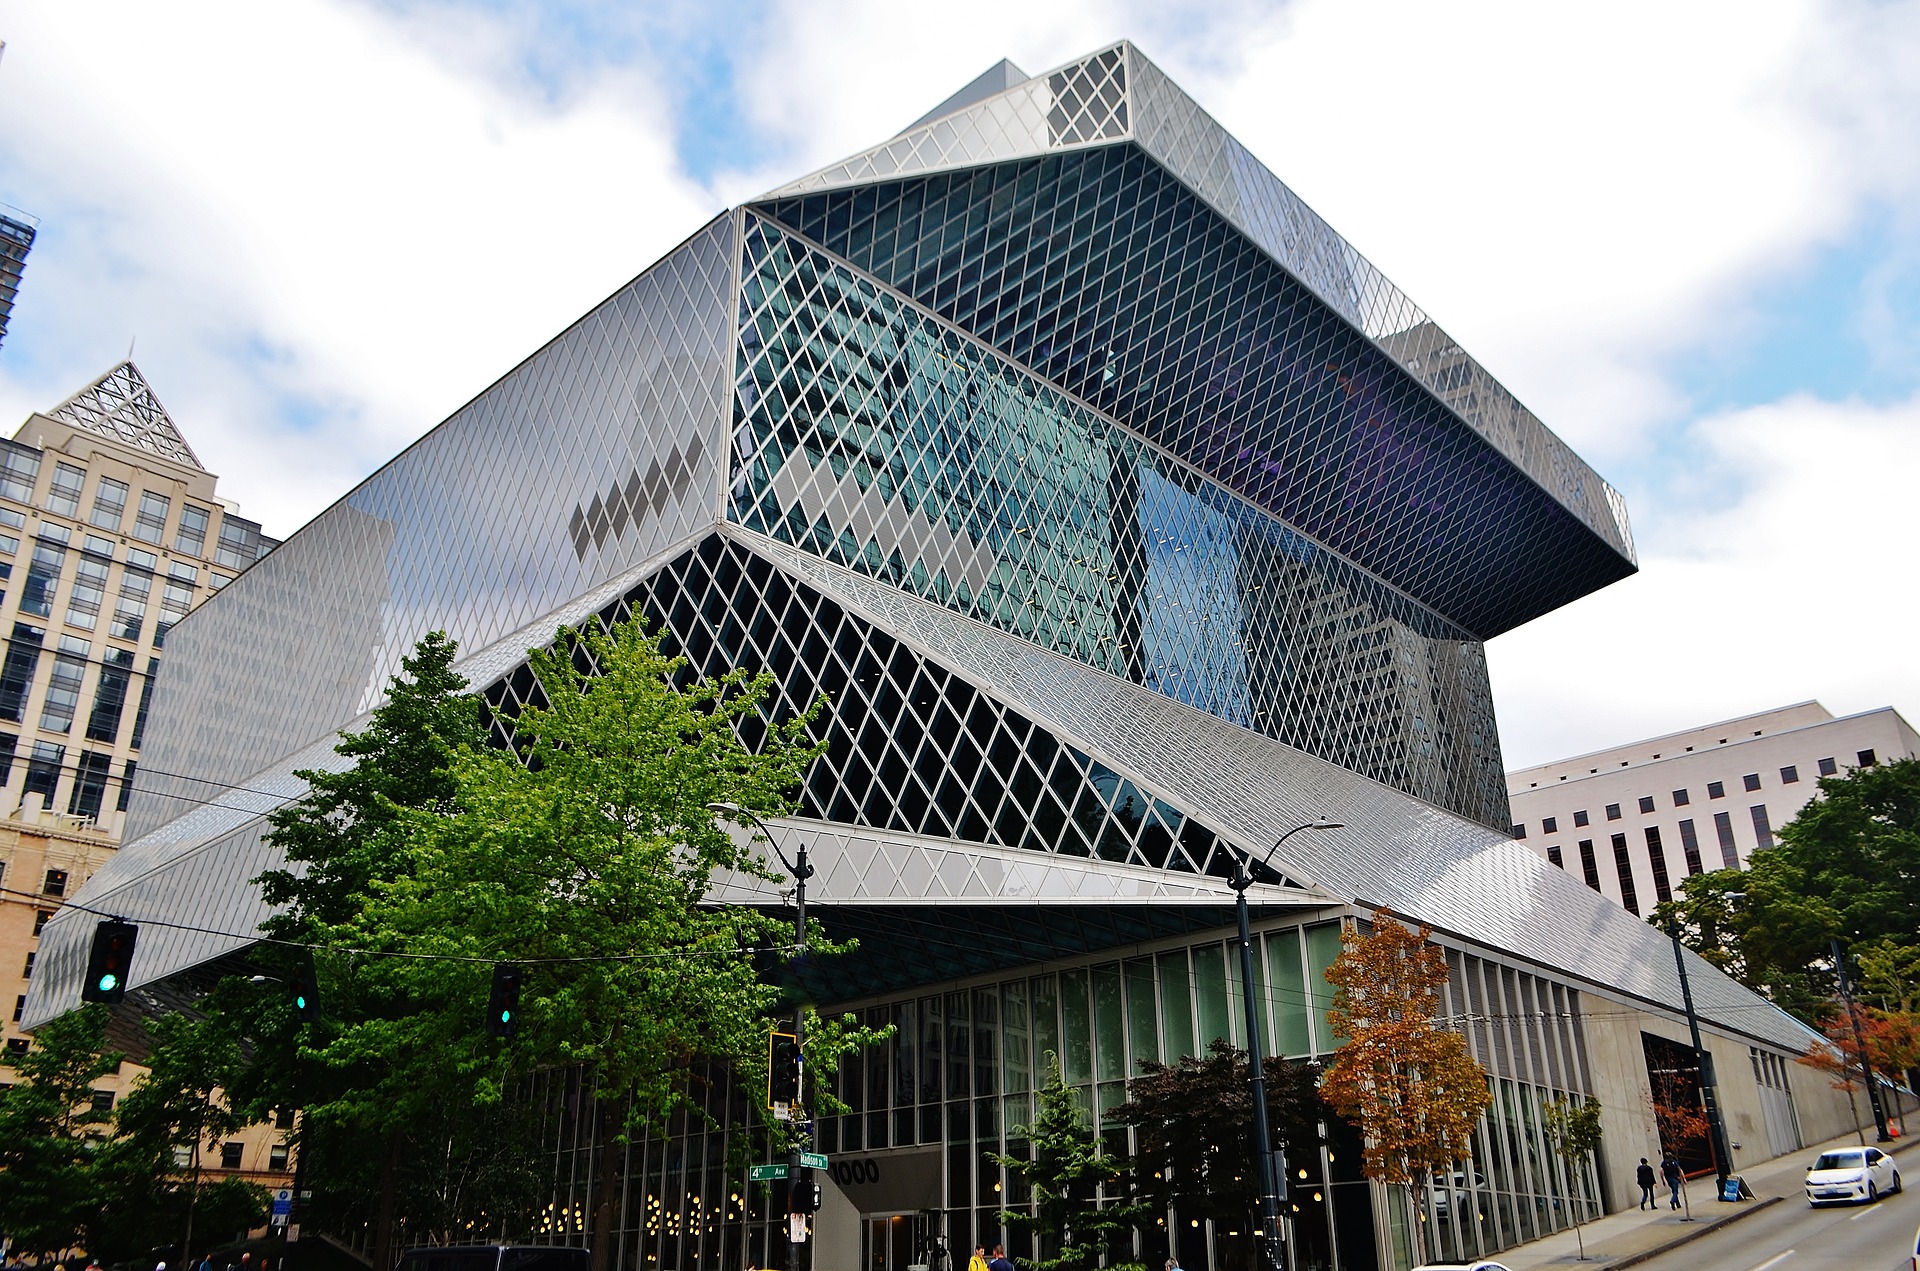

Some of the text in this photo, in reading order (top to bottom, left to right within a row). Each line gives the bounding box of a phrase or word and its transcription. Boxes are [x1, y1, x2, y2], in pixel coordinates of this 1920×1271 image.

[800, 1154, 818, 1166] Madison
[775, 1168, 785, 1176] Ave
[830, 1158, 880, 1186] 1000
